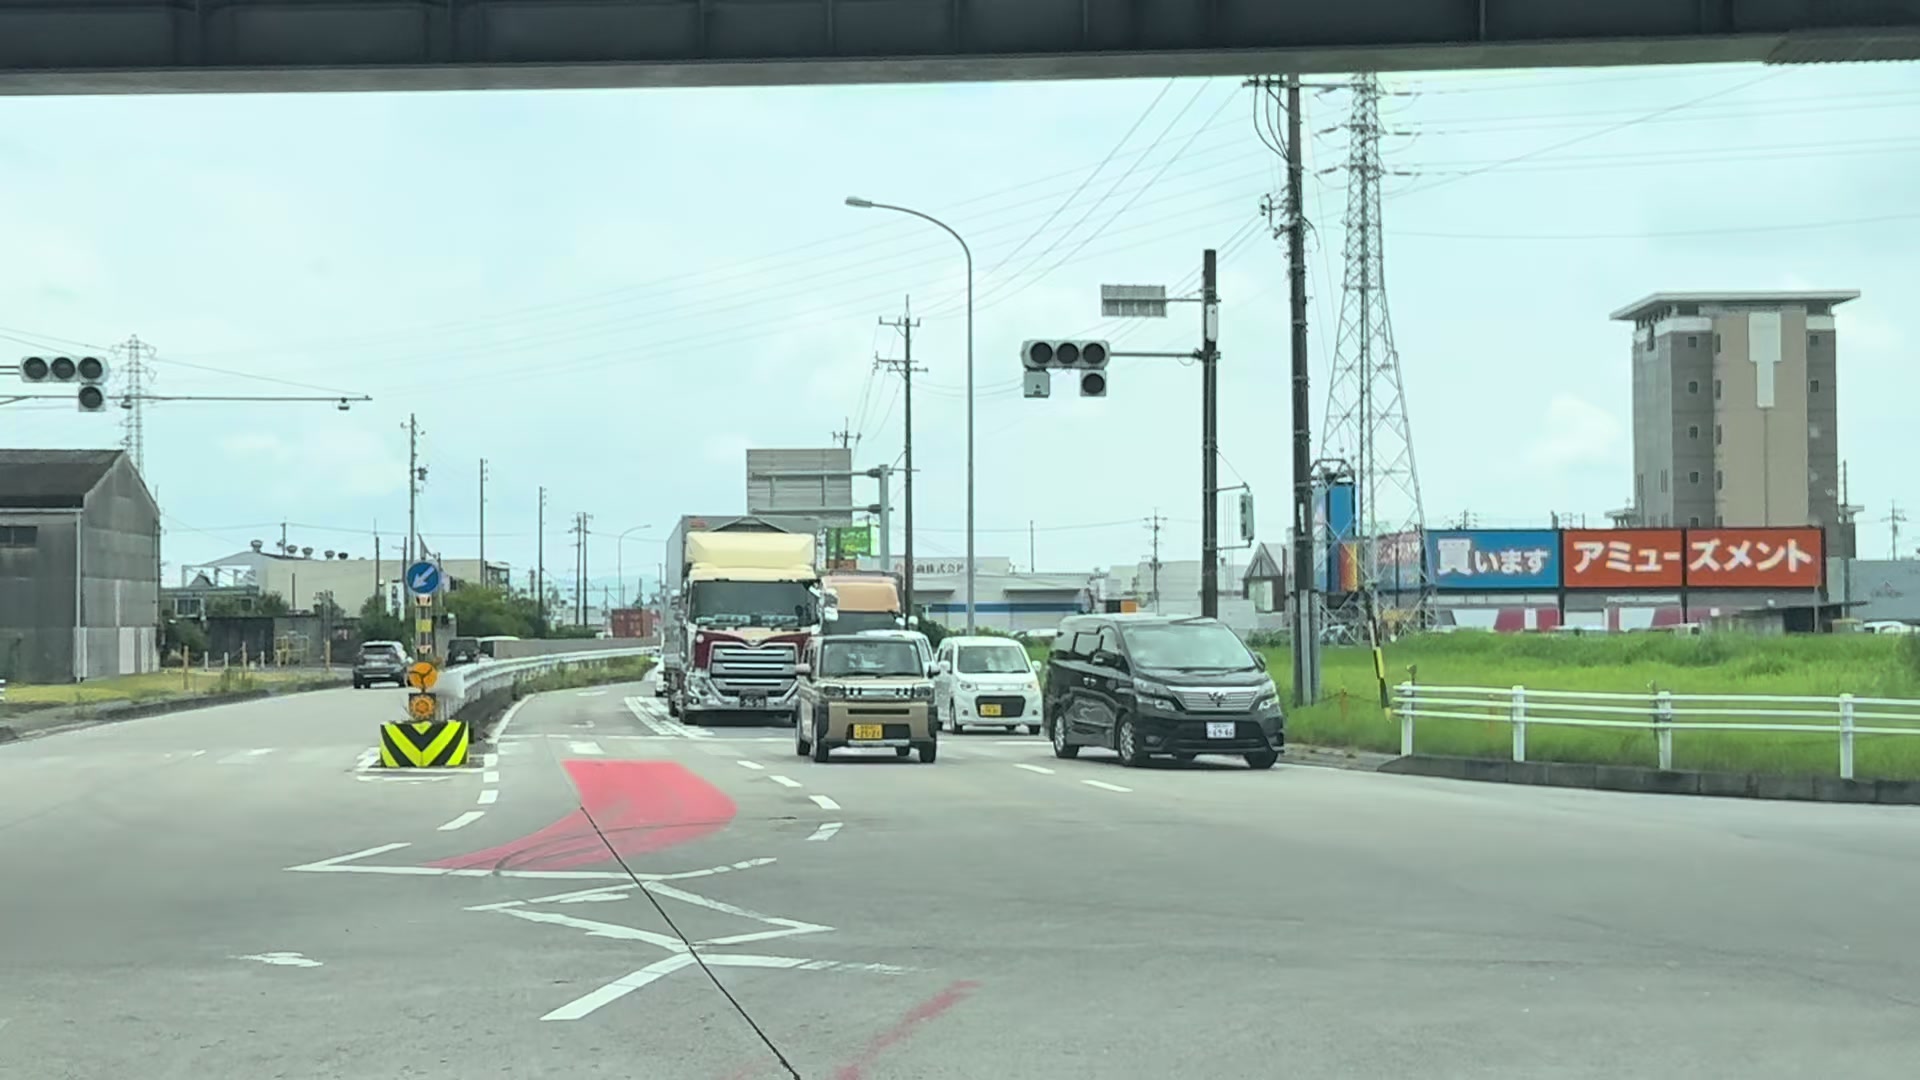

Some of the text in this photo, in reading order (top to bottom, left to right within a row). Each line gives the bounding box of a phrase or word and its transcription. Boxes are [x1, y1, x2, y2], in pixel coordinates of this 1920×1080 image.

[1437, 538, 1548, 576] 買います
[1573, 538, 1812, 573] アミューズメント
